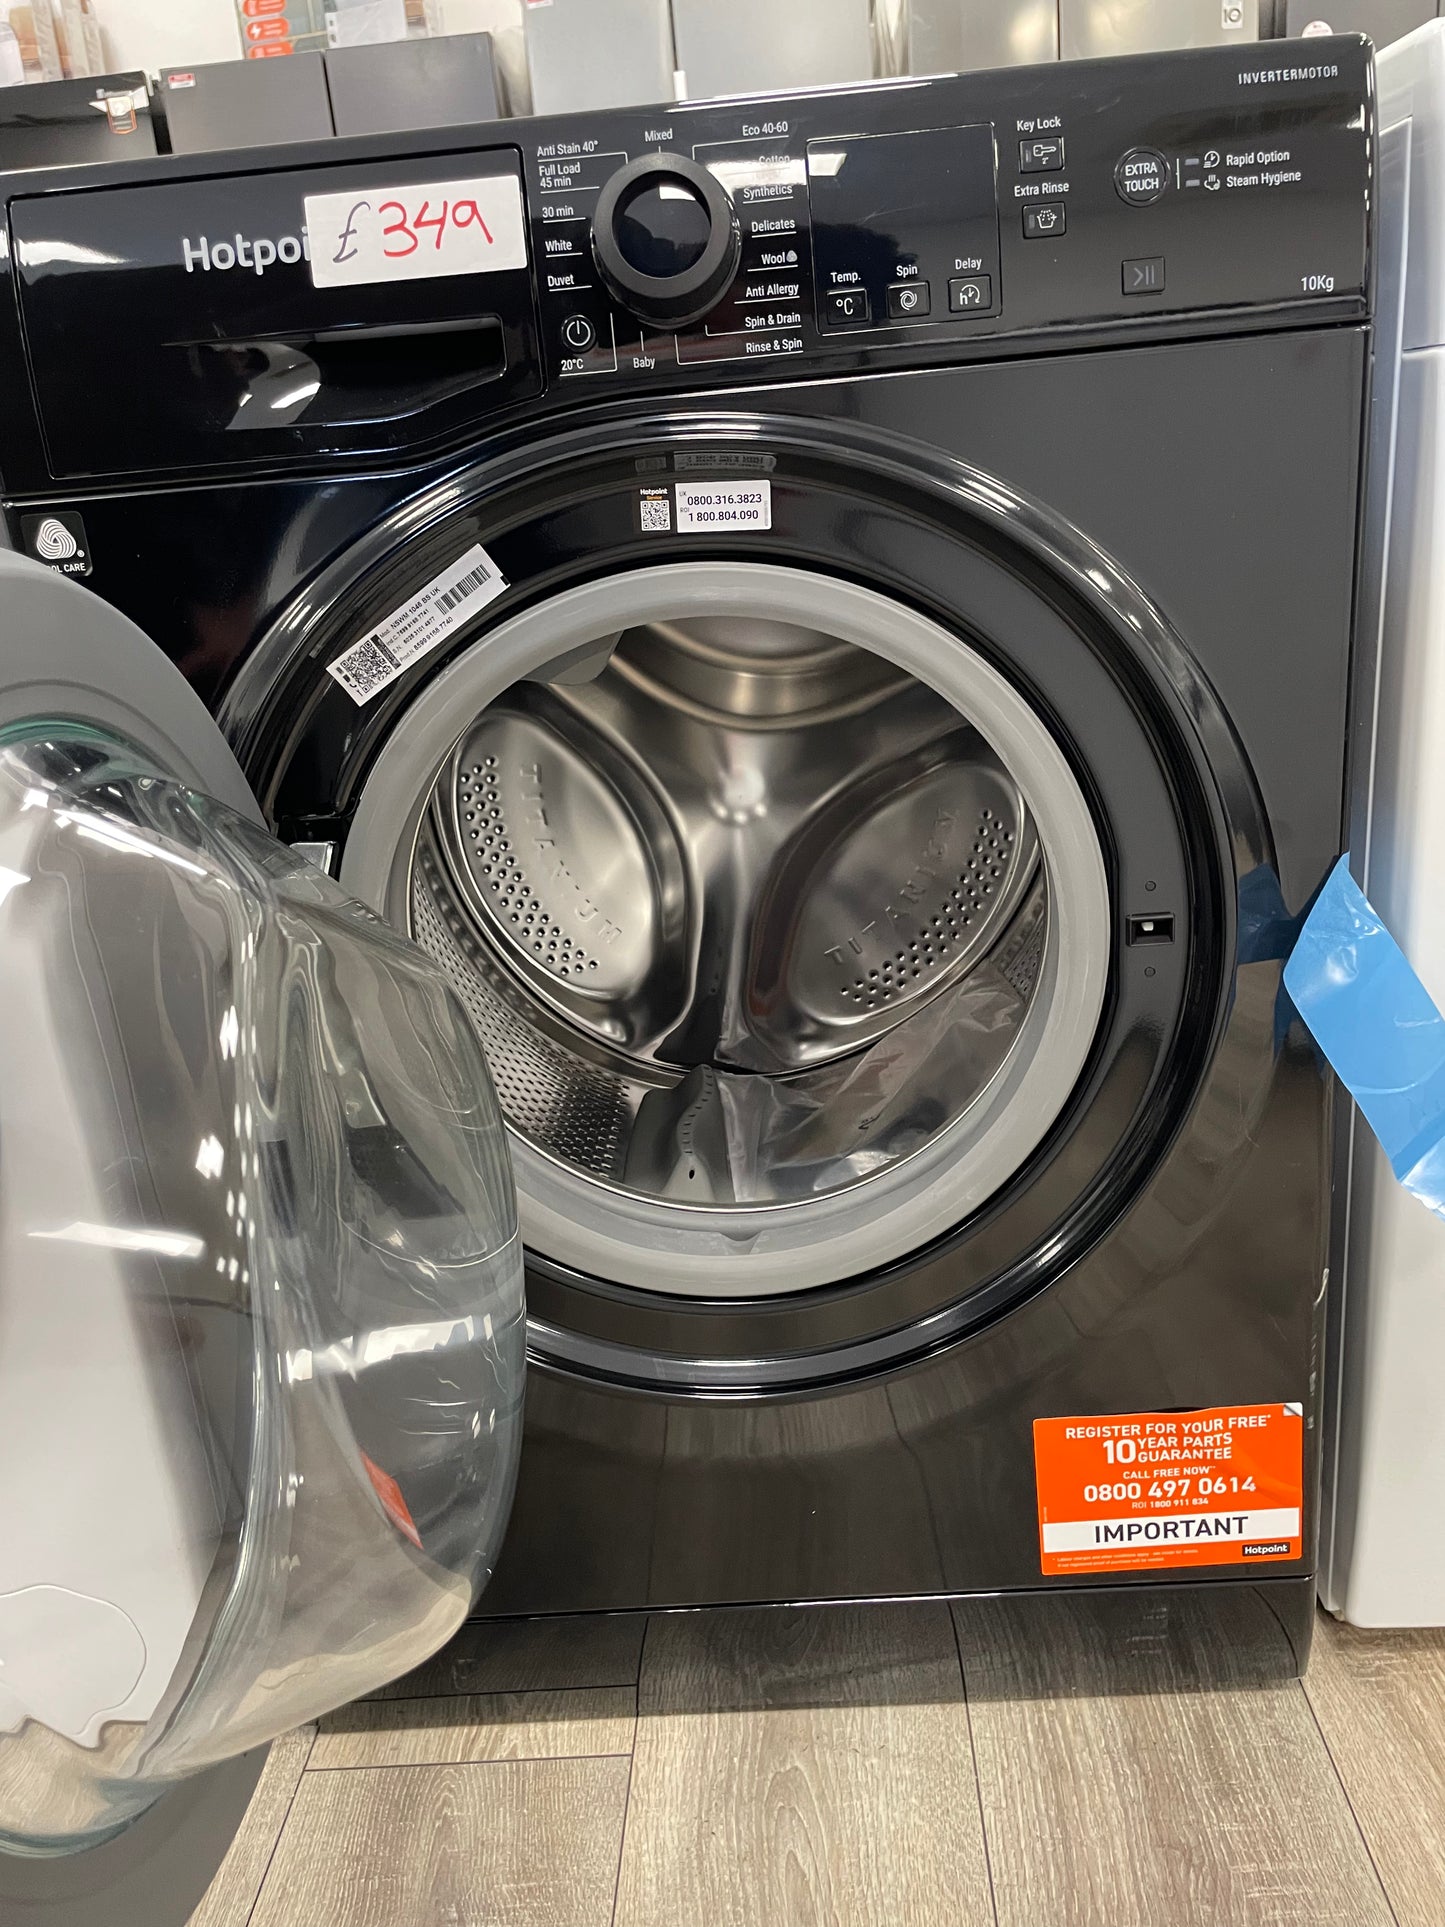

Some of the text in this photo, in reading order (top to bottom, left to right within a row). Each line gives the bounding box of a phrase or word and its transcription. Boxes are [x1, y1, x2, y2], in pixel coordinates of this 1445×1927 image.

[1237, 65, 1339, 85] INVERTERMOTOR
[742, 121, 789, 137] Eco 40-60
[1016, 116, 1062, 133] Key Lock
[644, 128, 673, 142] Mixed
[536, 140, 599, 158] Anti Stain 40°
[1226, 150, 1290, 168] Rapid Option
[538, 162, 581, 178] Full Load
[1125, 162, 1158, 177] EXTRA
[540, 176, 572, 189] 45 min
[1124, 177, 1160, 193] TOUCH
[1226, 170, 1302, 189] Steam Hygiene
[743, 185, 793, 202] Synthetics
[1014, 182, 1070, 198] Extra Rinse
[542, 205, 574, 219] 30 min
[332, 200, 493, 264] £349
[751, 218, 796, 233] Delicates
[183, 226, 311, 276] Hotpoi
[545, 239, 573, 253] White
[761, 252, 786, 266] Wool
[955, 258, 983, 273] Delay
[830, 271, 862, 284] Temp.
[896, 265, 918, 279] Spin
[547, 274, 575, 288] Duvet
[1301, 274, 1335, 292] 10Kg
[745, 282, 799, 299] Anti Allergy
[836, 298, 854, 316] °C
[744, 312, 801, 330] Spin & Drain
[746, 337, 803, 354] Rinse & Spin
[561, 357, 584, 371] 20°C
[633, 356, 656, 370] Baby
[640, 487, 668, 496] Hotpoint
[687, 493, 762, 506] 0800.316.3823
[689, 512, 694, 522] 1
[696, 509, 759, 522] 800.804.090
[47, 562, 86, 574] OL CARE
[390, 611, 410, 630] NSWM
[430, 586, 441, 598] UK
[439, 616, 454, 630] 7740
[1065, 1424, 1141, 1439] REGISTER
[1146, 1423, 1177, 1435] FOR
[1181, 1419, 1224, 1434] YOUR
[1102, 1432, 1233, 1464] 10 YEAR PARTS
[1137, 1447, 1232, 1463] GUARANTEE
[1123, 1470, 1150, 1479] CALL
[1153, 1467, 1180, 1478] FREE
[1083, 1476, 1256, 1502] 0800 497 0614
[1131, 1501, 1147, 1509] ROI
[1150, 1500, 1172, 1509] 1800
[1173, 1499, 1190, 1507] 911
[1094, 1516, 1249, 1544] IMPORTANT
[1244, 1543, 1288, 1556] Hotpoint
